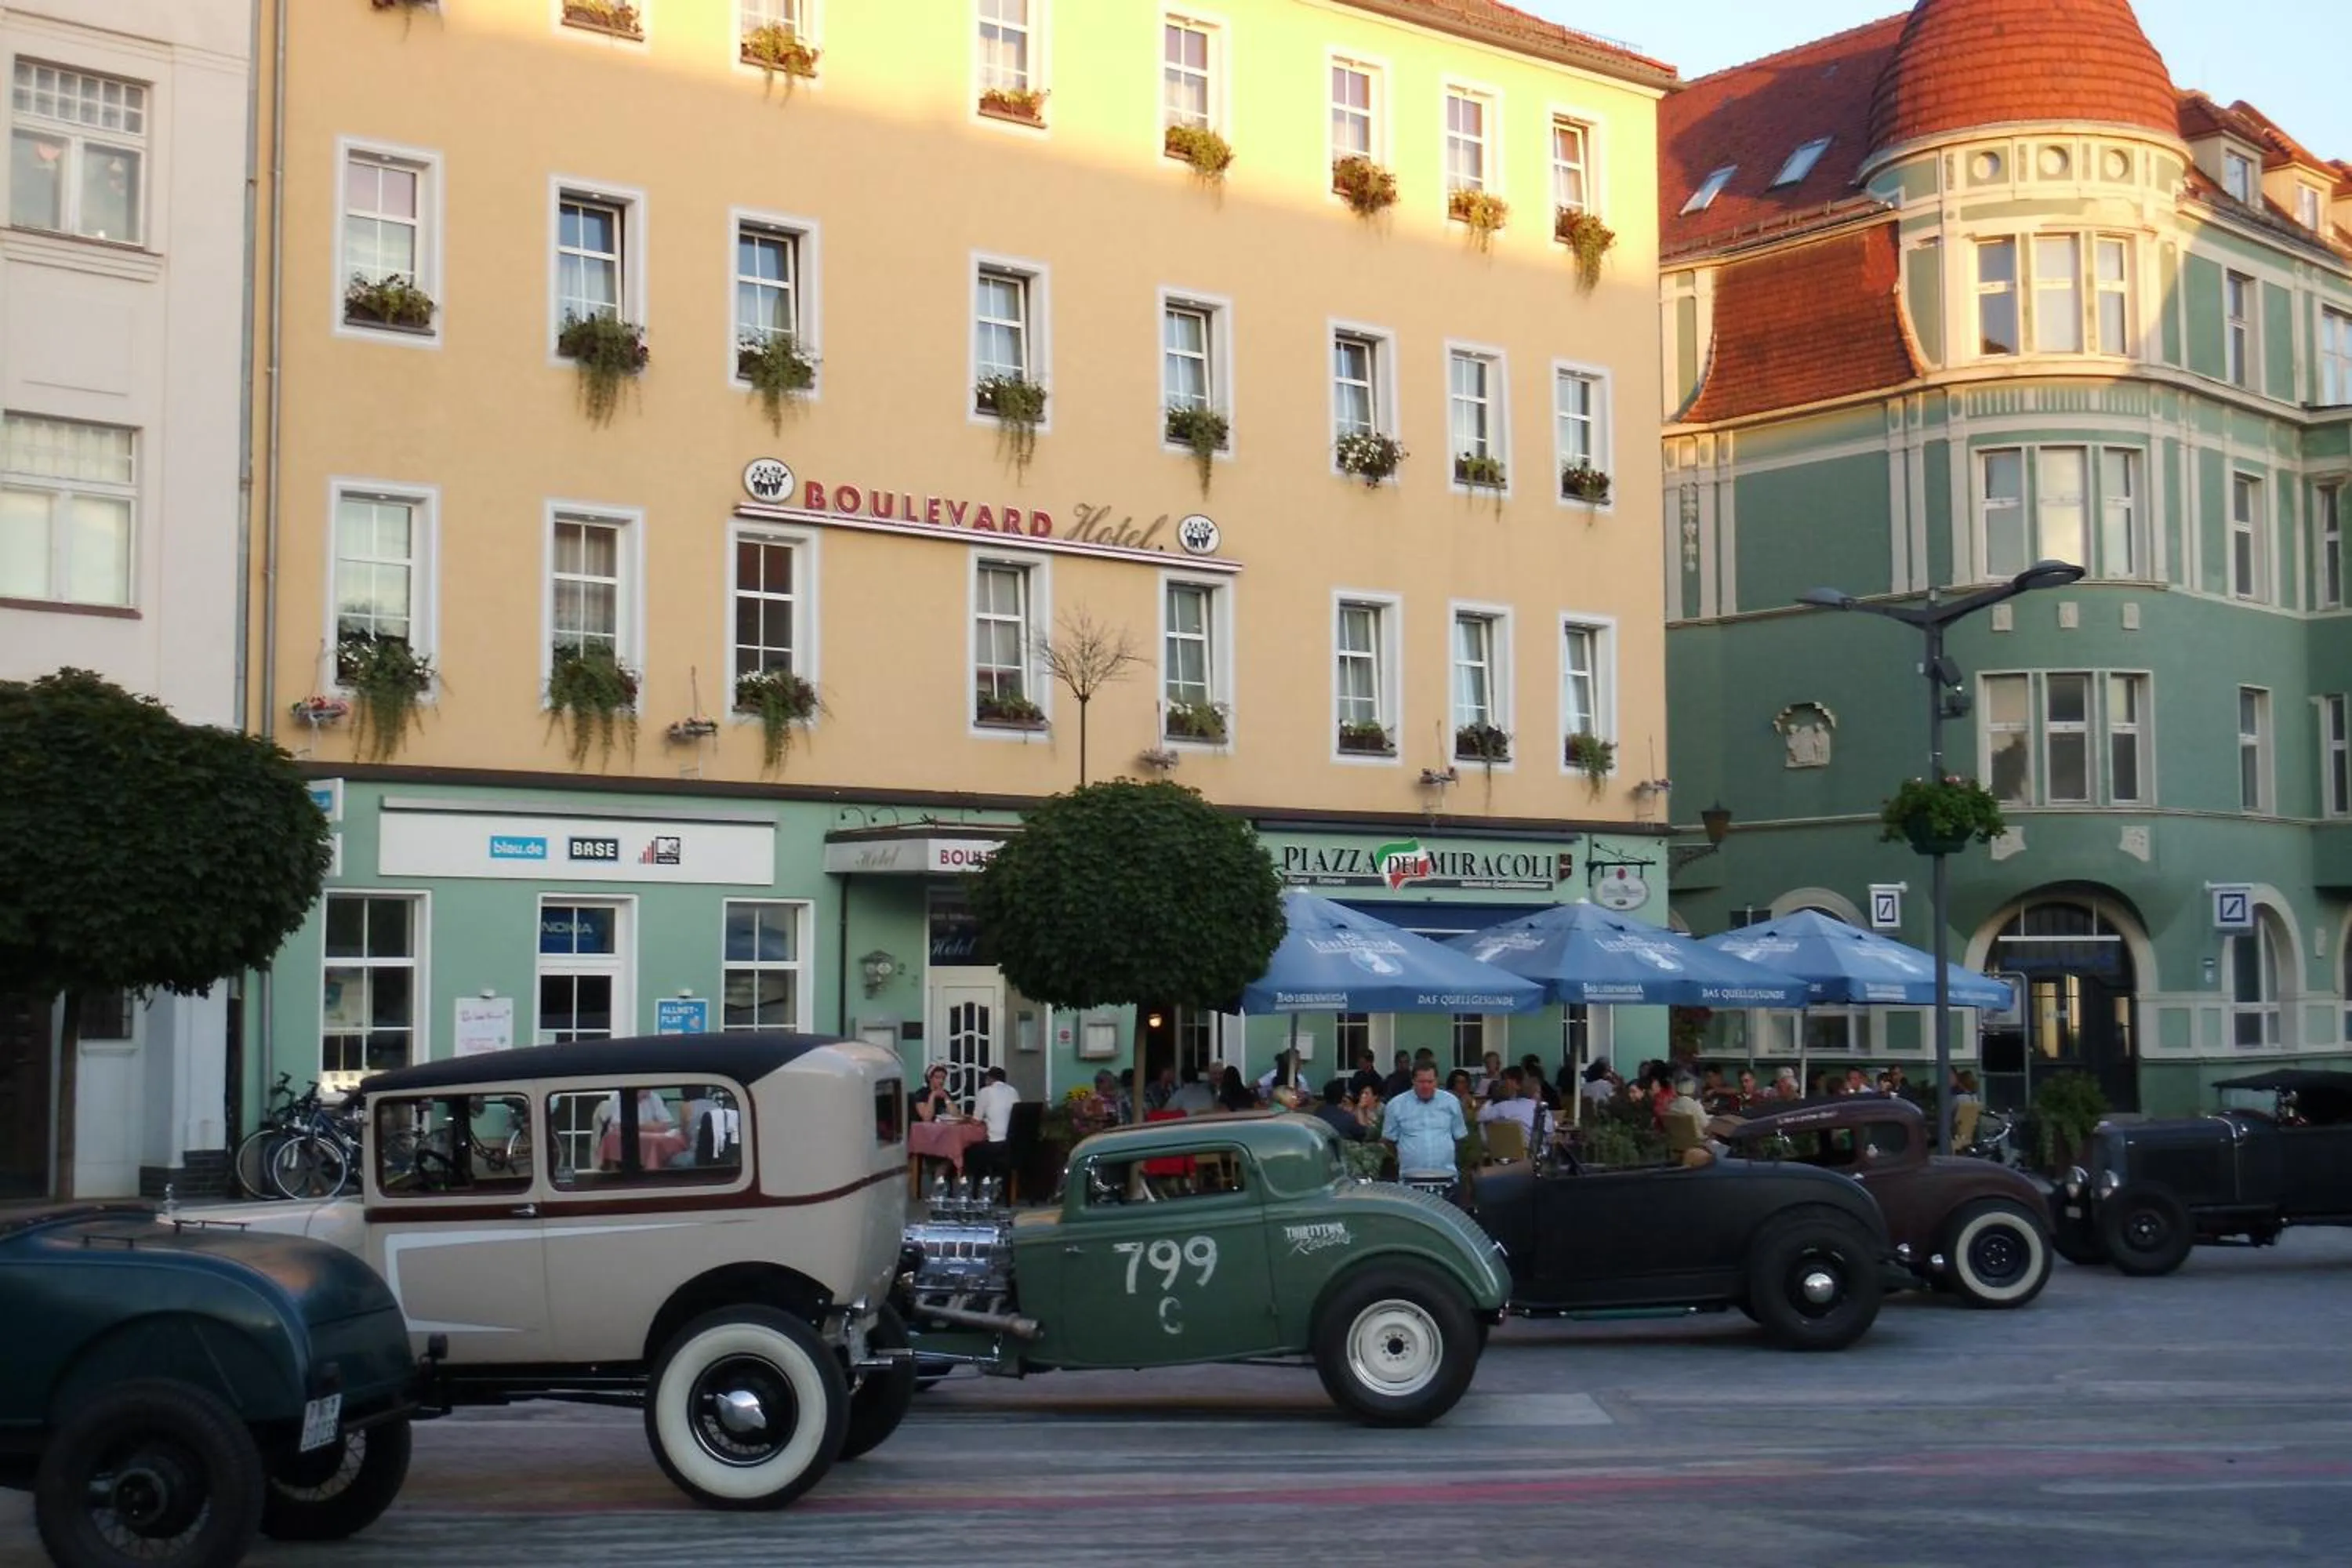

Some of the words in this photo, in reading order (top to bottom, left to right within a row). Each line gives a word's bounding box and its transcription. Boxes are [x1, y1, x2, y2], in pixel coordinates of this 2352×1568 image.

[804, 480, 1054, 539] BOULEVARD
[493, 839, 544, 856] blau.de
[572, 841, 615, 857] BASE
[1283, 846, 1379, 874] PIAZZA
[1428, 851, 1555, 878] MIRACOLI
[1112, 1235, 1218, 1294] 799
